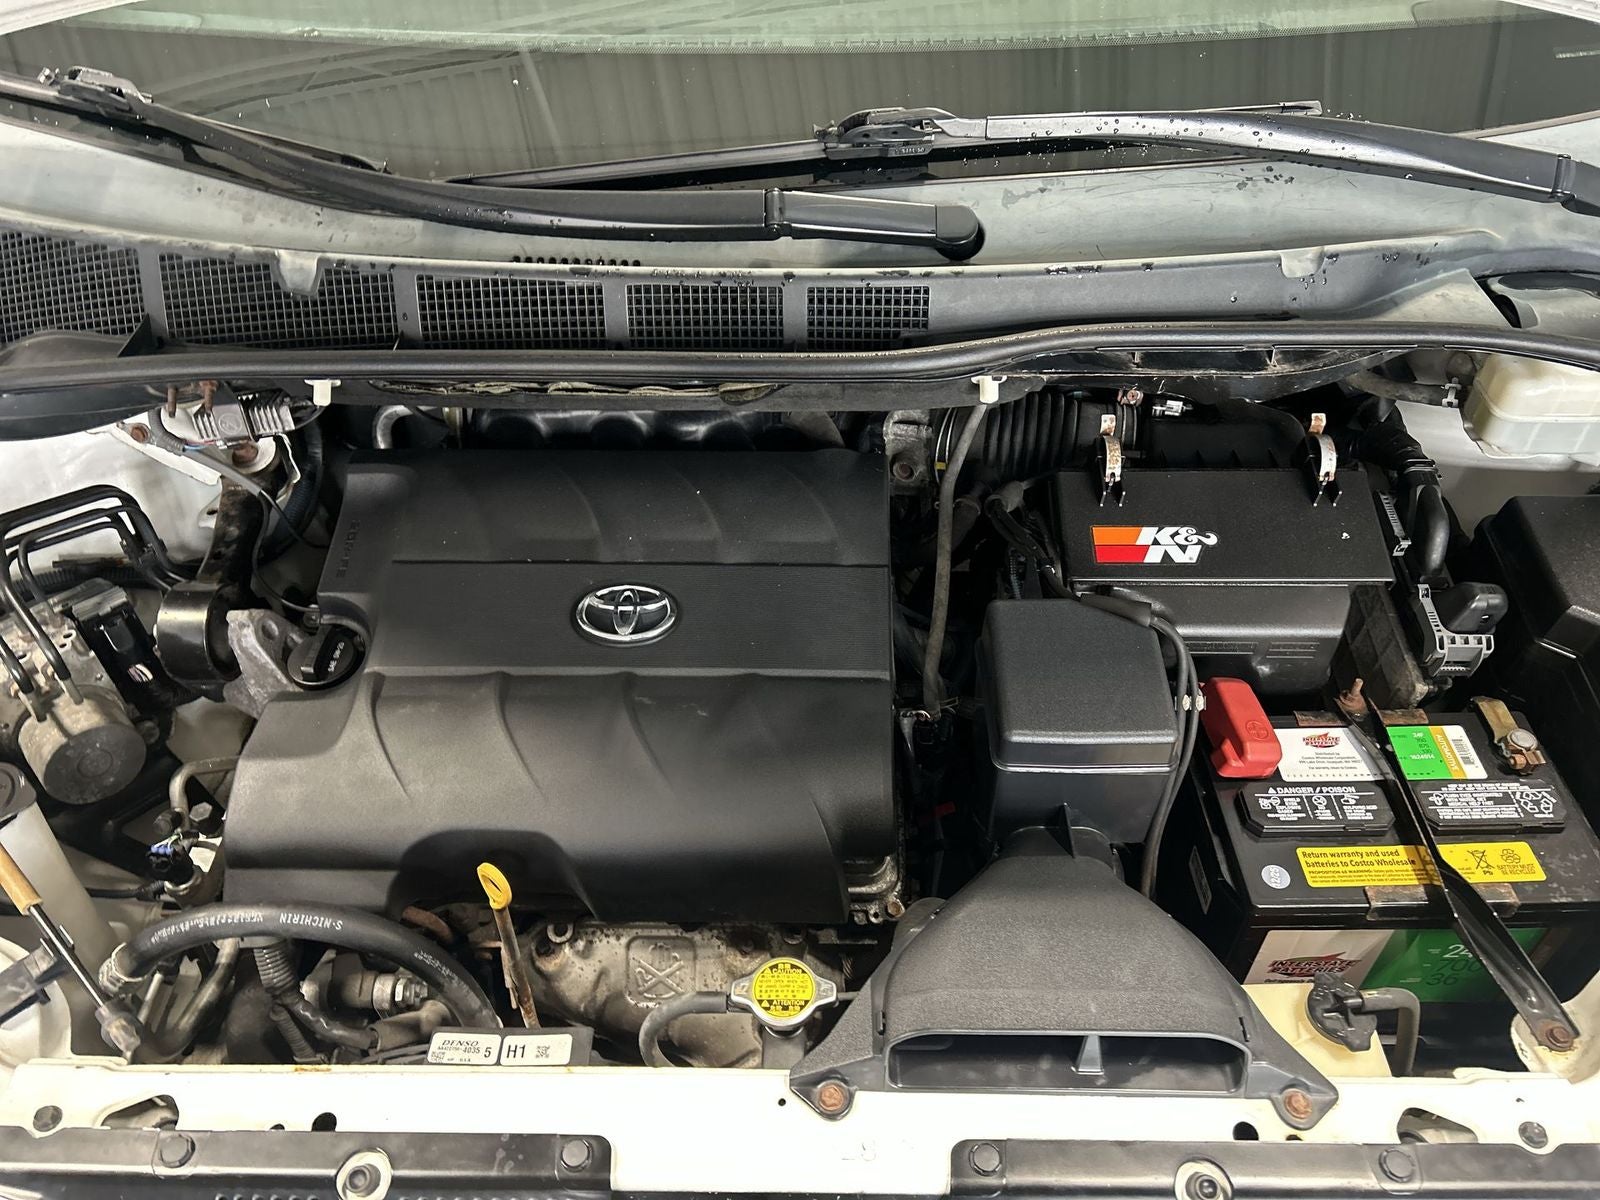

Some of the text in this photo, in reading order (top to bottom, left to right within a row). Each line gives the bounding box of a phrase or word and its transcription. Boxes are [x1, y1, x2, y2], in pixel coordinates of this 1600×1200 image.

[1135, 526, 1219, 564] K&N
[1435, 733, 1459, 772] AUTOMOTIVE
[1329, 850, 1364, 859] warranty
[1365, 849, 1380, 857] and
[1381, 849, 1400, 857] used
[1305, 860, 1340, 868] batteries
[1435, 958, 1482, 972] 700
[483, 1046, 492, 1058] 5
[506, 1044, 526, 1059] H1
